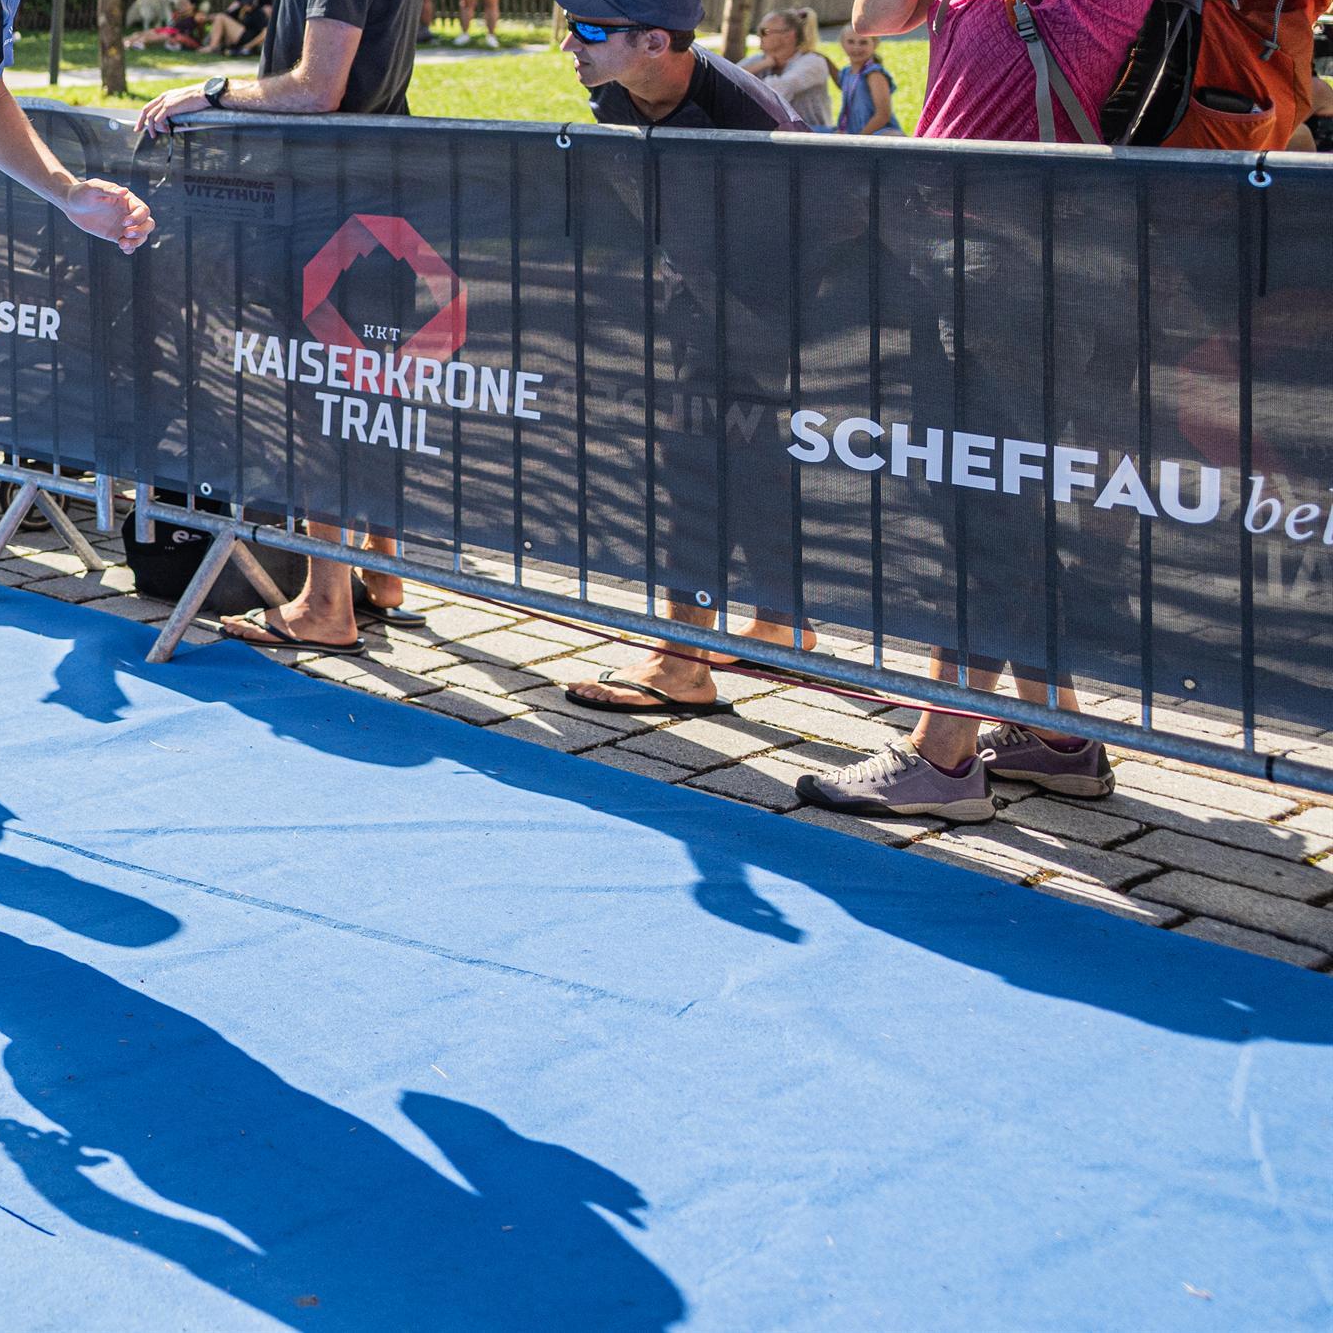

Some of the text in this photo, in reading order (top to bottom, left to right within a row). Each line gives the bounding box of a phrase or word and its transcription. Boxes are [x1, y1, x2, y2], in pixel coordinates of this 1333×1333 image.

[184, 184, 276, 204] VITZTHUM
[362, 323, 401, 342] KKT
[233, 330, 544, 421] KAISERKRONE
[314, 392, 441, 456] TRAIL
[787, 410, 1221, 525] SCHEFFAU
